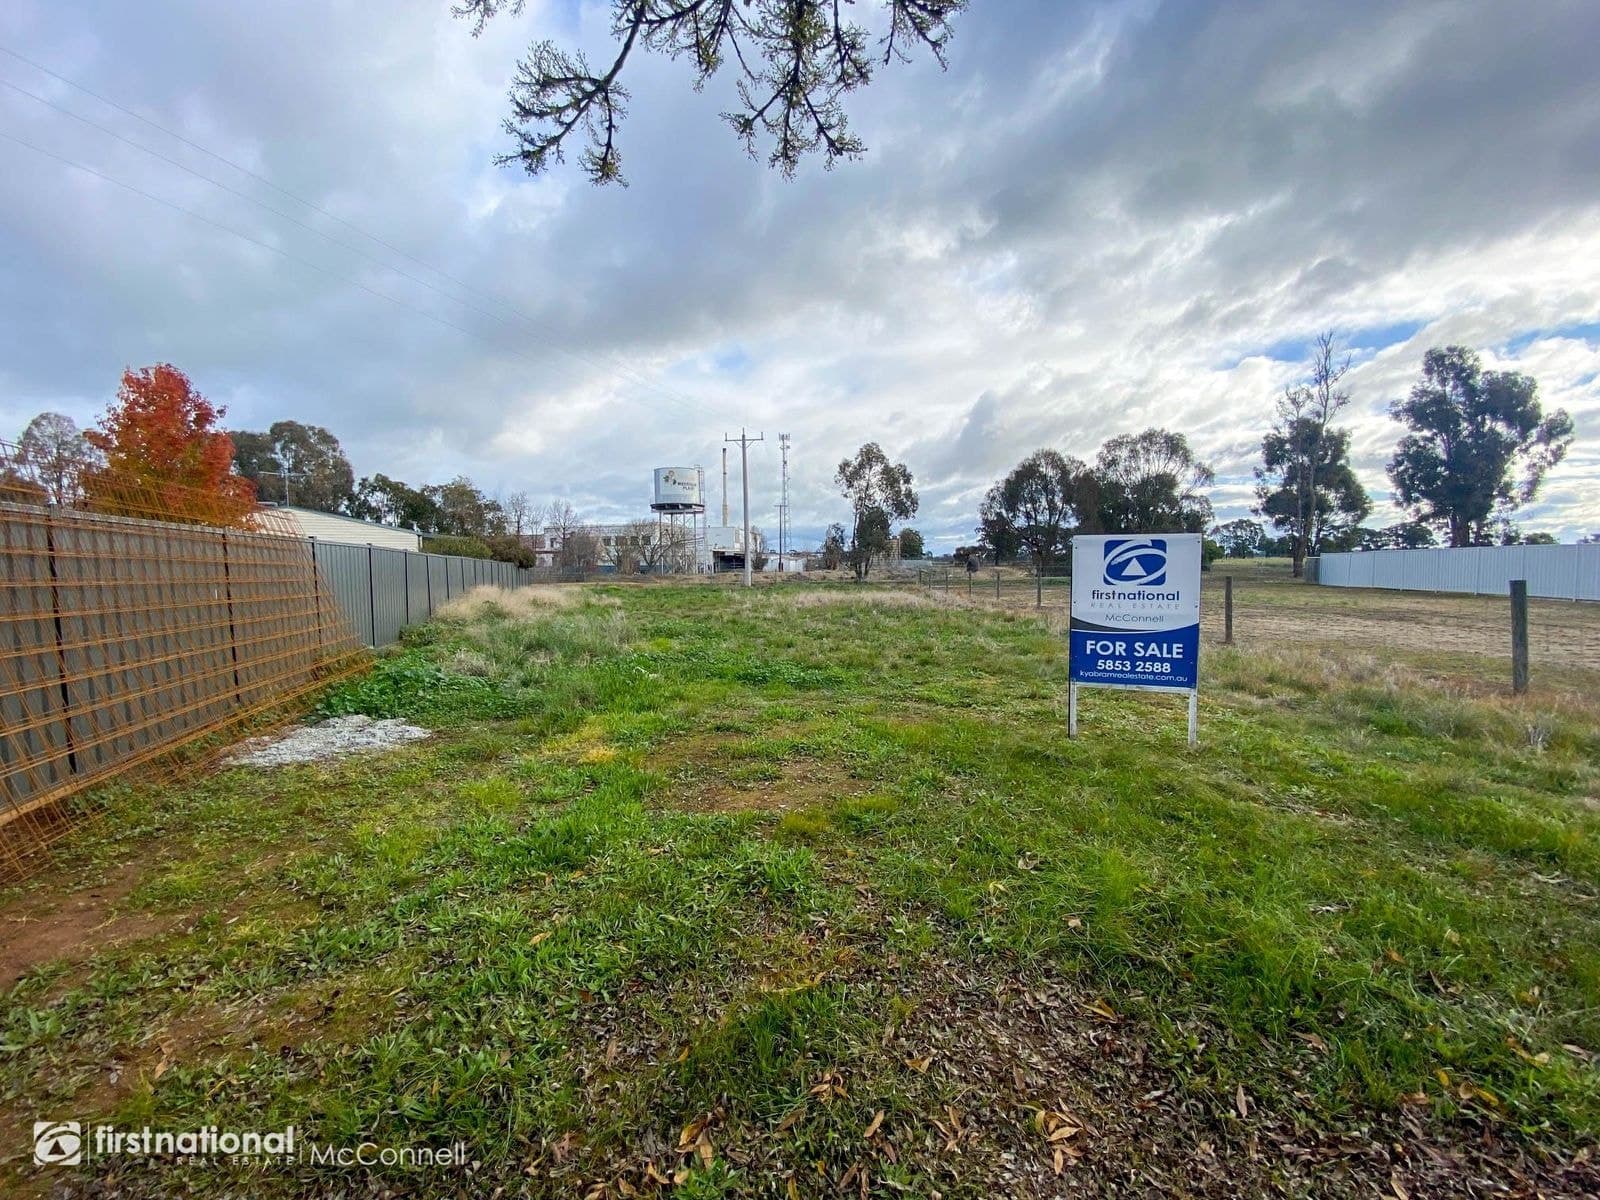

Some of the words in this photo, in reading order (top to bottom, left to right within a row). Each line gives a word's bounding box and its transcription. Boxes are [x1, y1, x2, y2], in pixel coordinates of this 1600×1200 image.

[1092, 589, 1180, 601] firstnational
[1105, 613, 1164, 623] McConnell
[1086, 640, 1127, 656] FOR
[1134, 642, 1183, 658] SALE
[1096, 659, 1131, 671] 5853
[1135, 661, 1171, 673] 2588
[1080, 670, 1188, 682] kyabramrealestate.com.au
